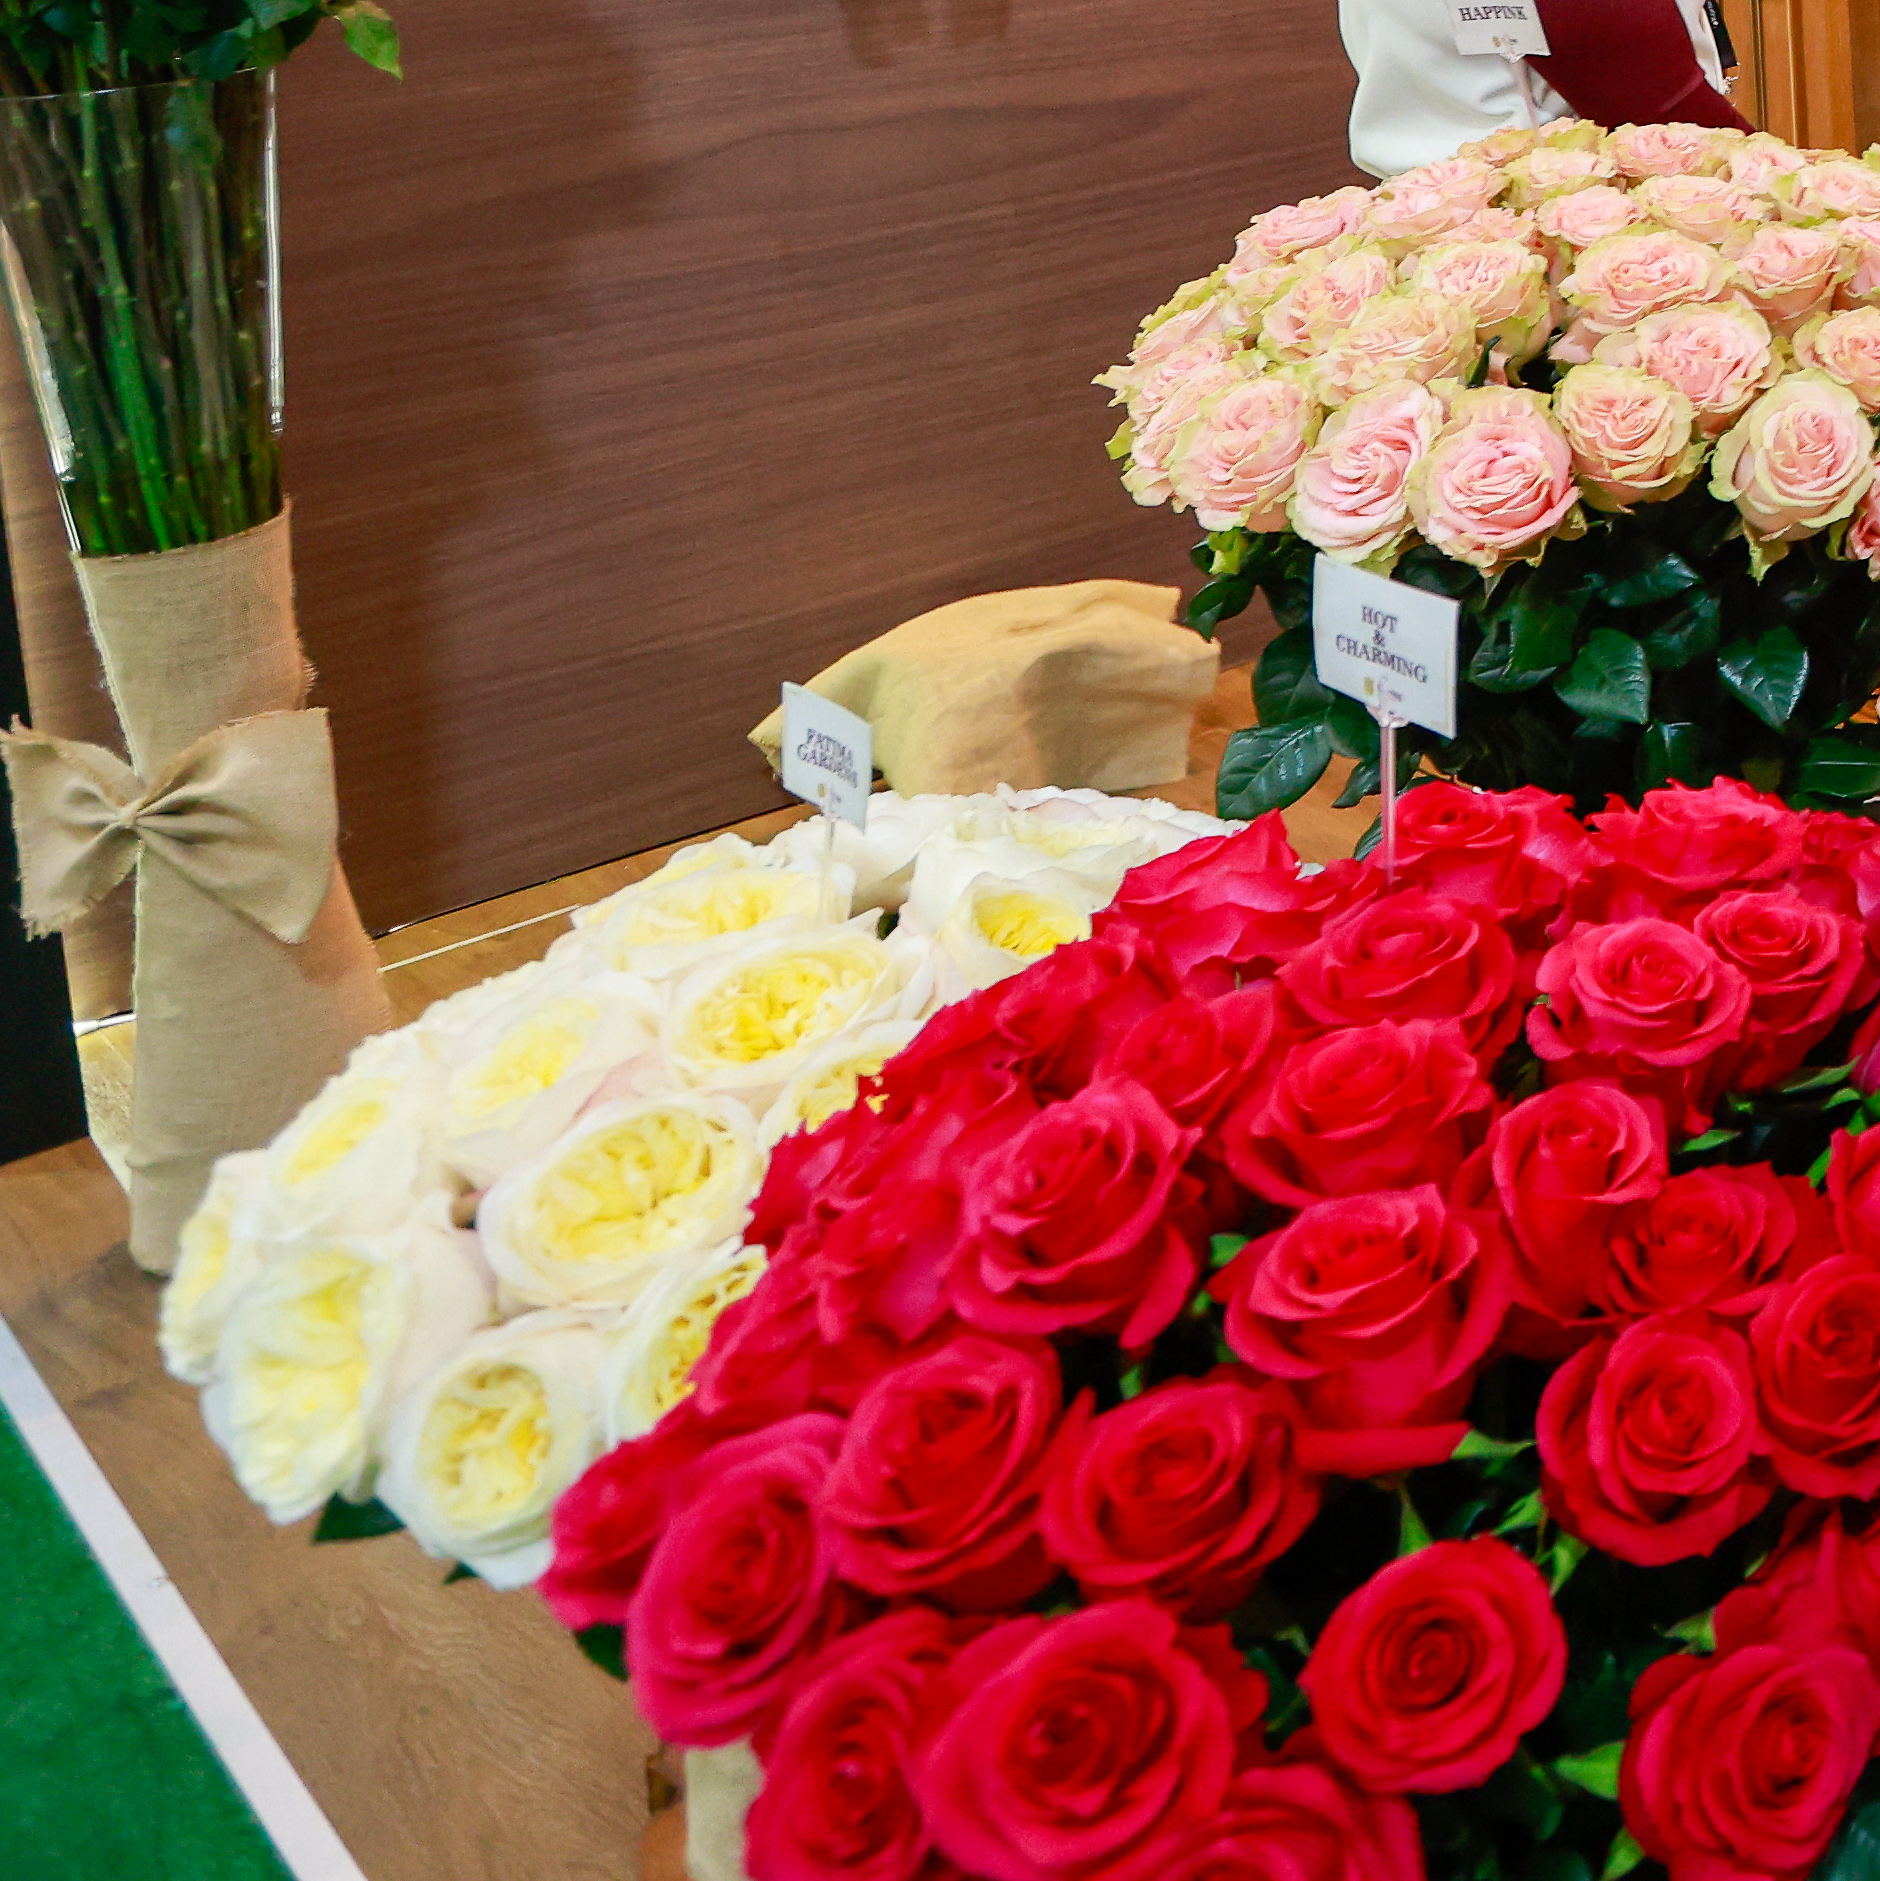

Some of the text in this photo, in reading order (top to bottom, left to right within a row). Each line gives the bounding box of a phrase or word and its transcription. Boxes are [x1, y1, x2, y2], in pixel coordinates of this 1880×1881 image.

[1459, 5, 1528, 22] HAPPINK
[1361, 605, 1399, 634] HOT
[1372, 630, 1386, 647] &
[1335, 633, 1428, 684] CHARMING
